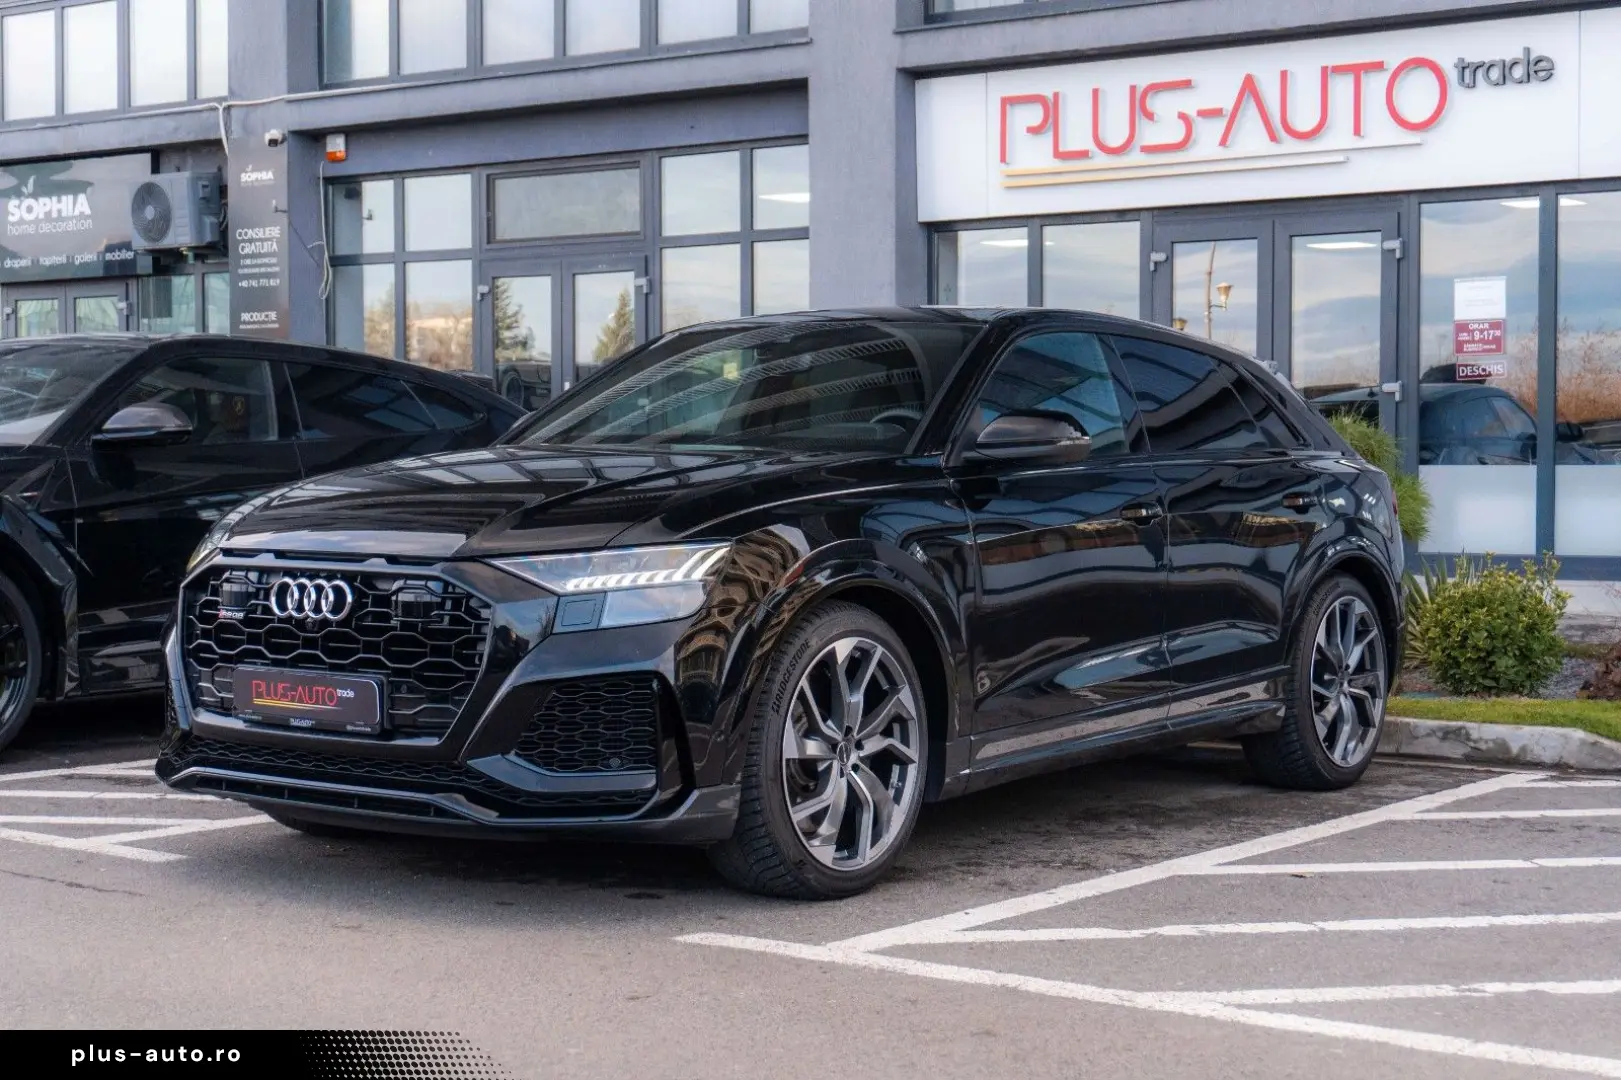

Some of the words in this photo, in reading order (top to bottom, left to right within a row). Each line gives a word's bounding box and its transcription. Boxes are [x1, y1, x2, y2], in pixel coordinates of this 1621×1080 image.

[1000, 57, 1449, 164] PLUS-AUTO
[1454, 47, 1555, 89] trade
[240, 171, 274, 181] SOPHIA
[7, 192, 92, 222] SOPHIA
[7, 223, 36, 235] home
[38, 218, 93, 233] decoration
[1459, 364, 1504, 376] DESCHIS
[771, 638, 812, 715] BRIDGESTONE
[251, 680, 338, 706] PLUS-AUTO
[336, 688, 355, 698] trade
